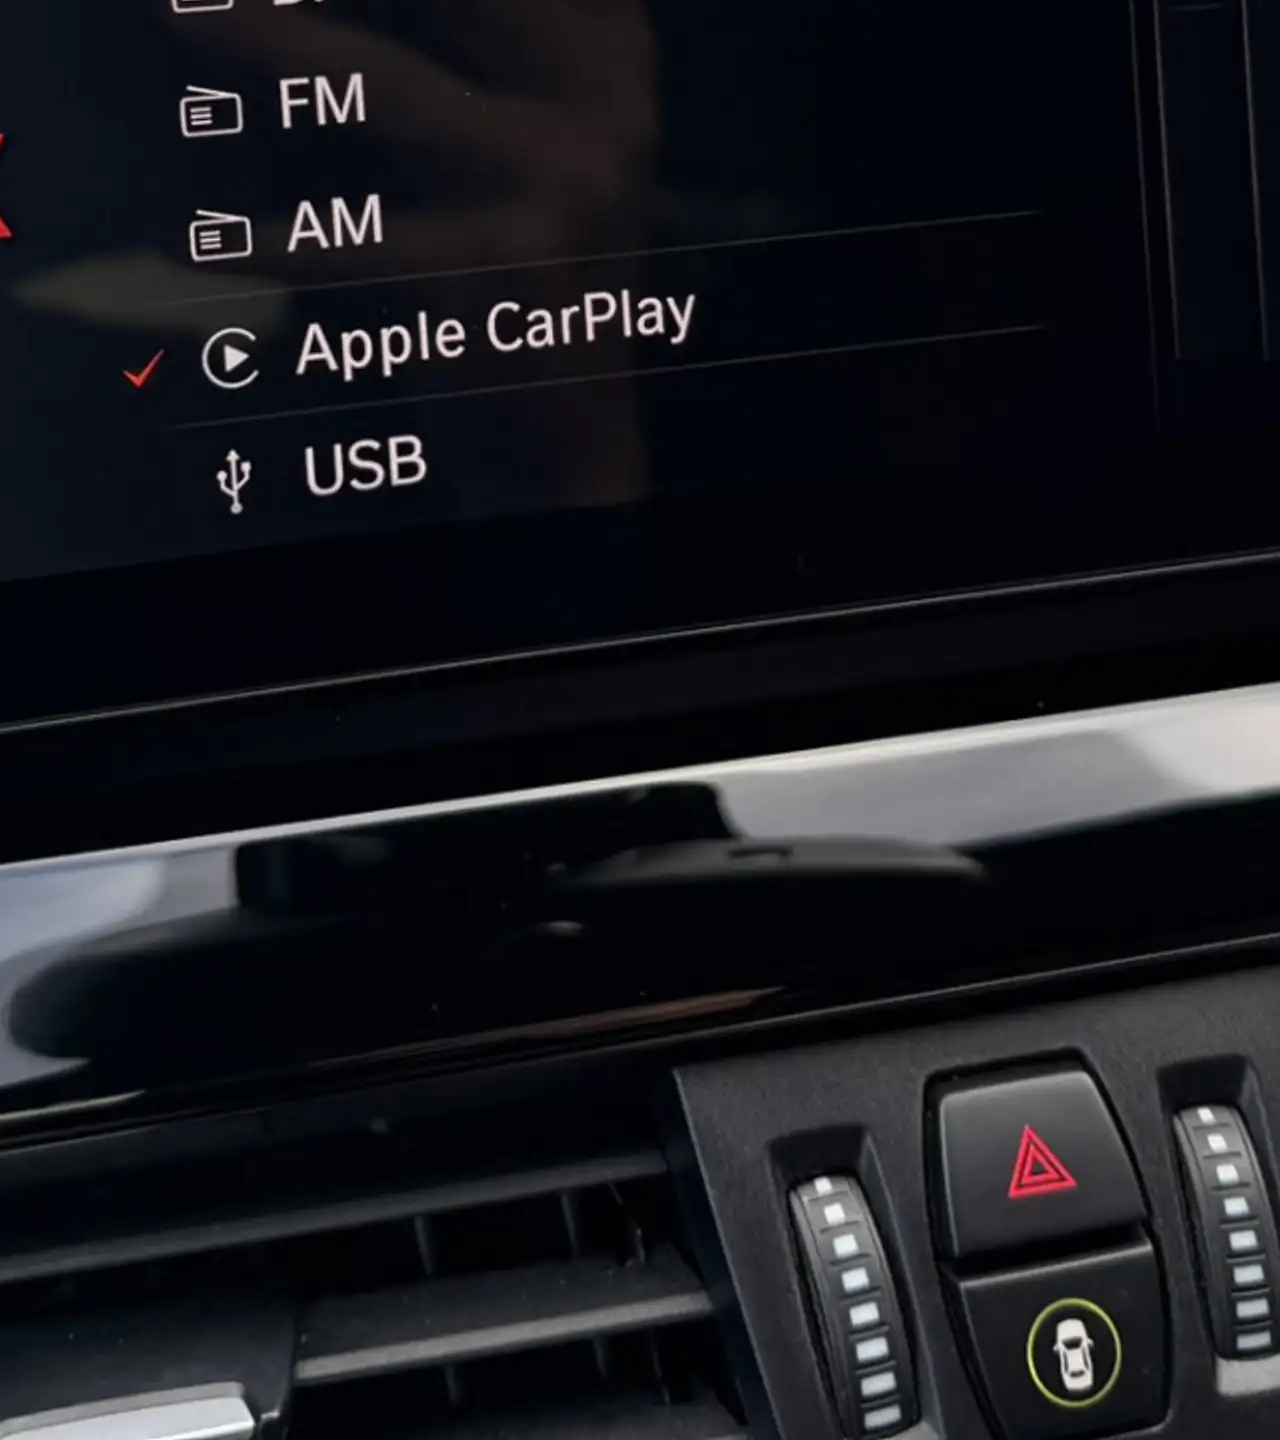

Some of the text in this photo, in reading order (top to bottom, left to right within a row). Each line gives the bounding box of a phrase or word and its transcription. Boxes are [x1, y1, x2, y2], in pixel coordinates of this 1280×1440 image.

[279, 72, 367, 129] FM
[287, 193, 384, 253] AM
[296, 289, 696, 382] Apple CarPlay
[305, 435, 428, 496] USB
